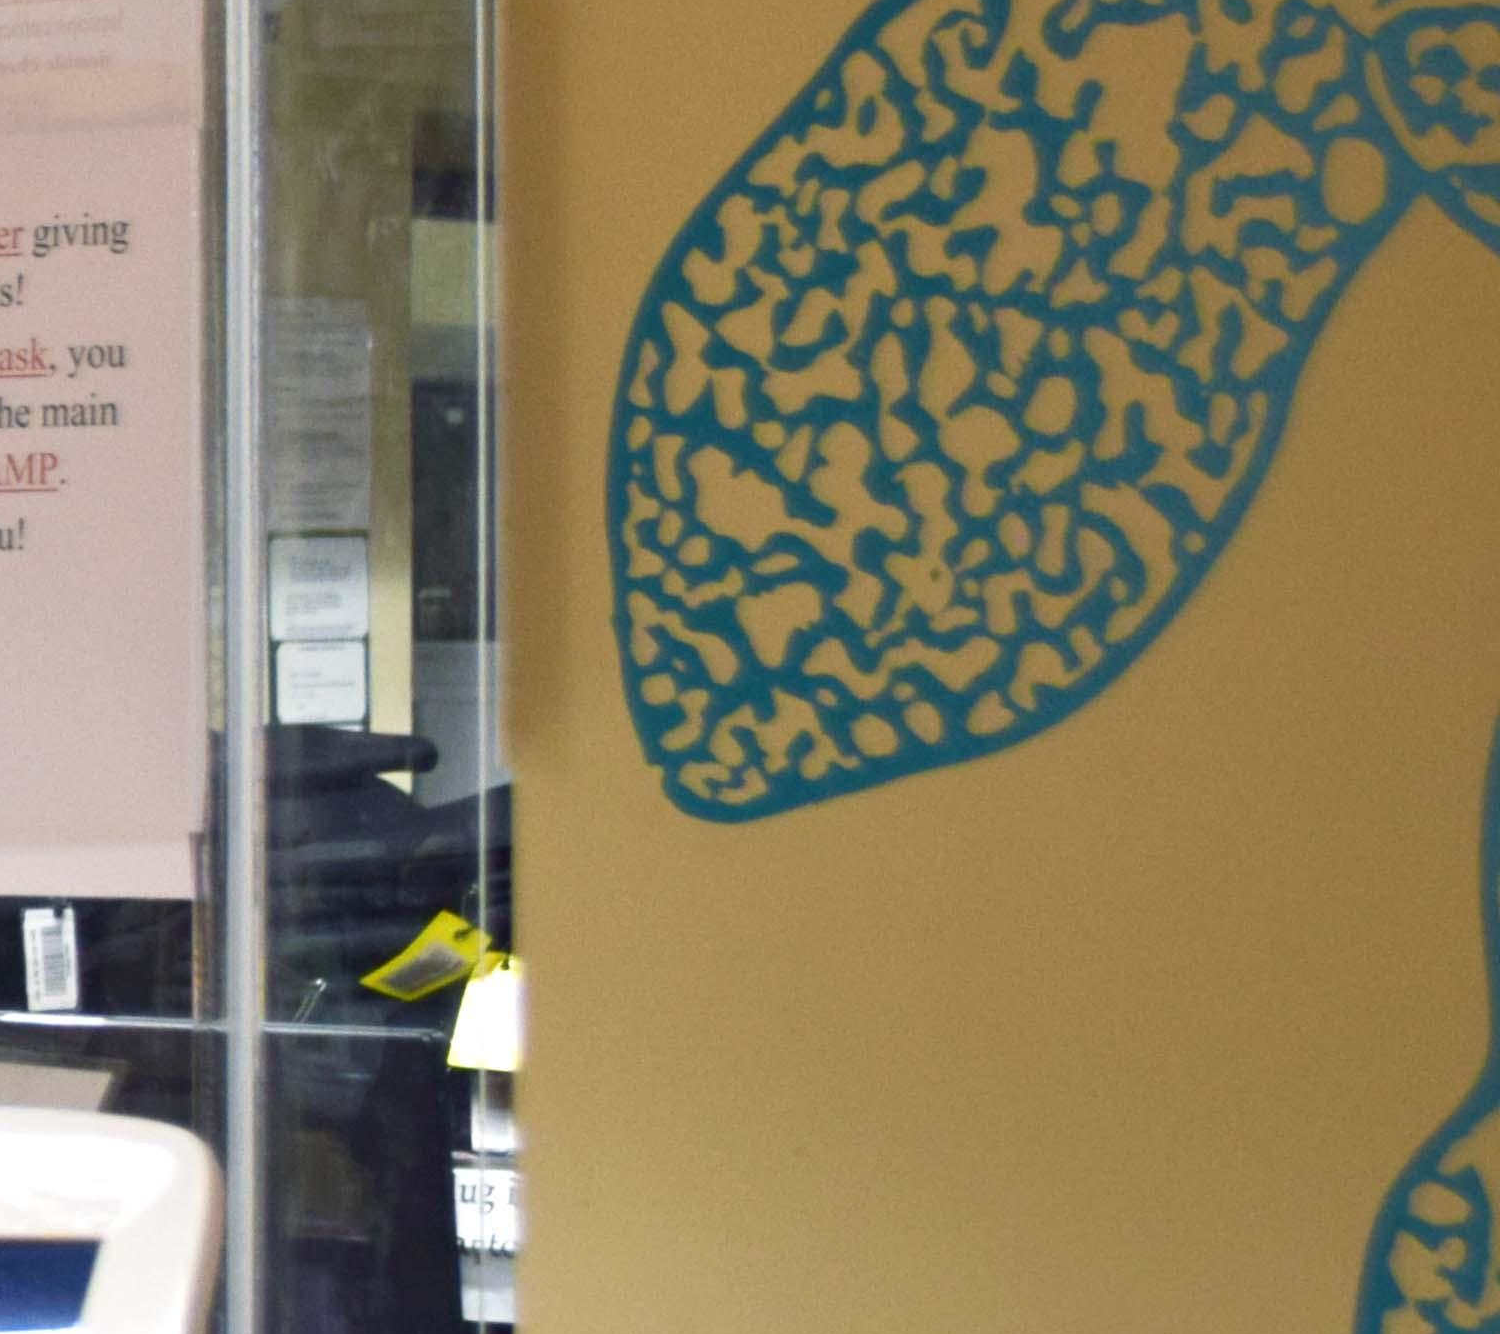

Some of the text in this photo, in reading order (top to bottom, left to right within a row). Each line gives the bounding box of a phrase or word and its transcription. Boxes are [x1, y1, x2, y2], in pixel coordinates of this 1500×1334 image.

[33, 214, 131, 258] giving
[68, 343, 125, 378] you
[41, 392, 118, 427] main
